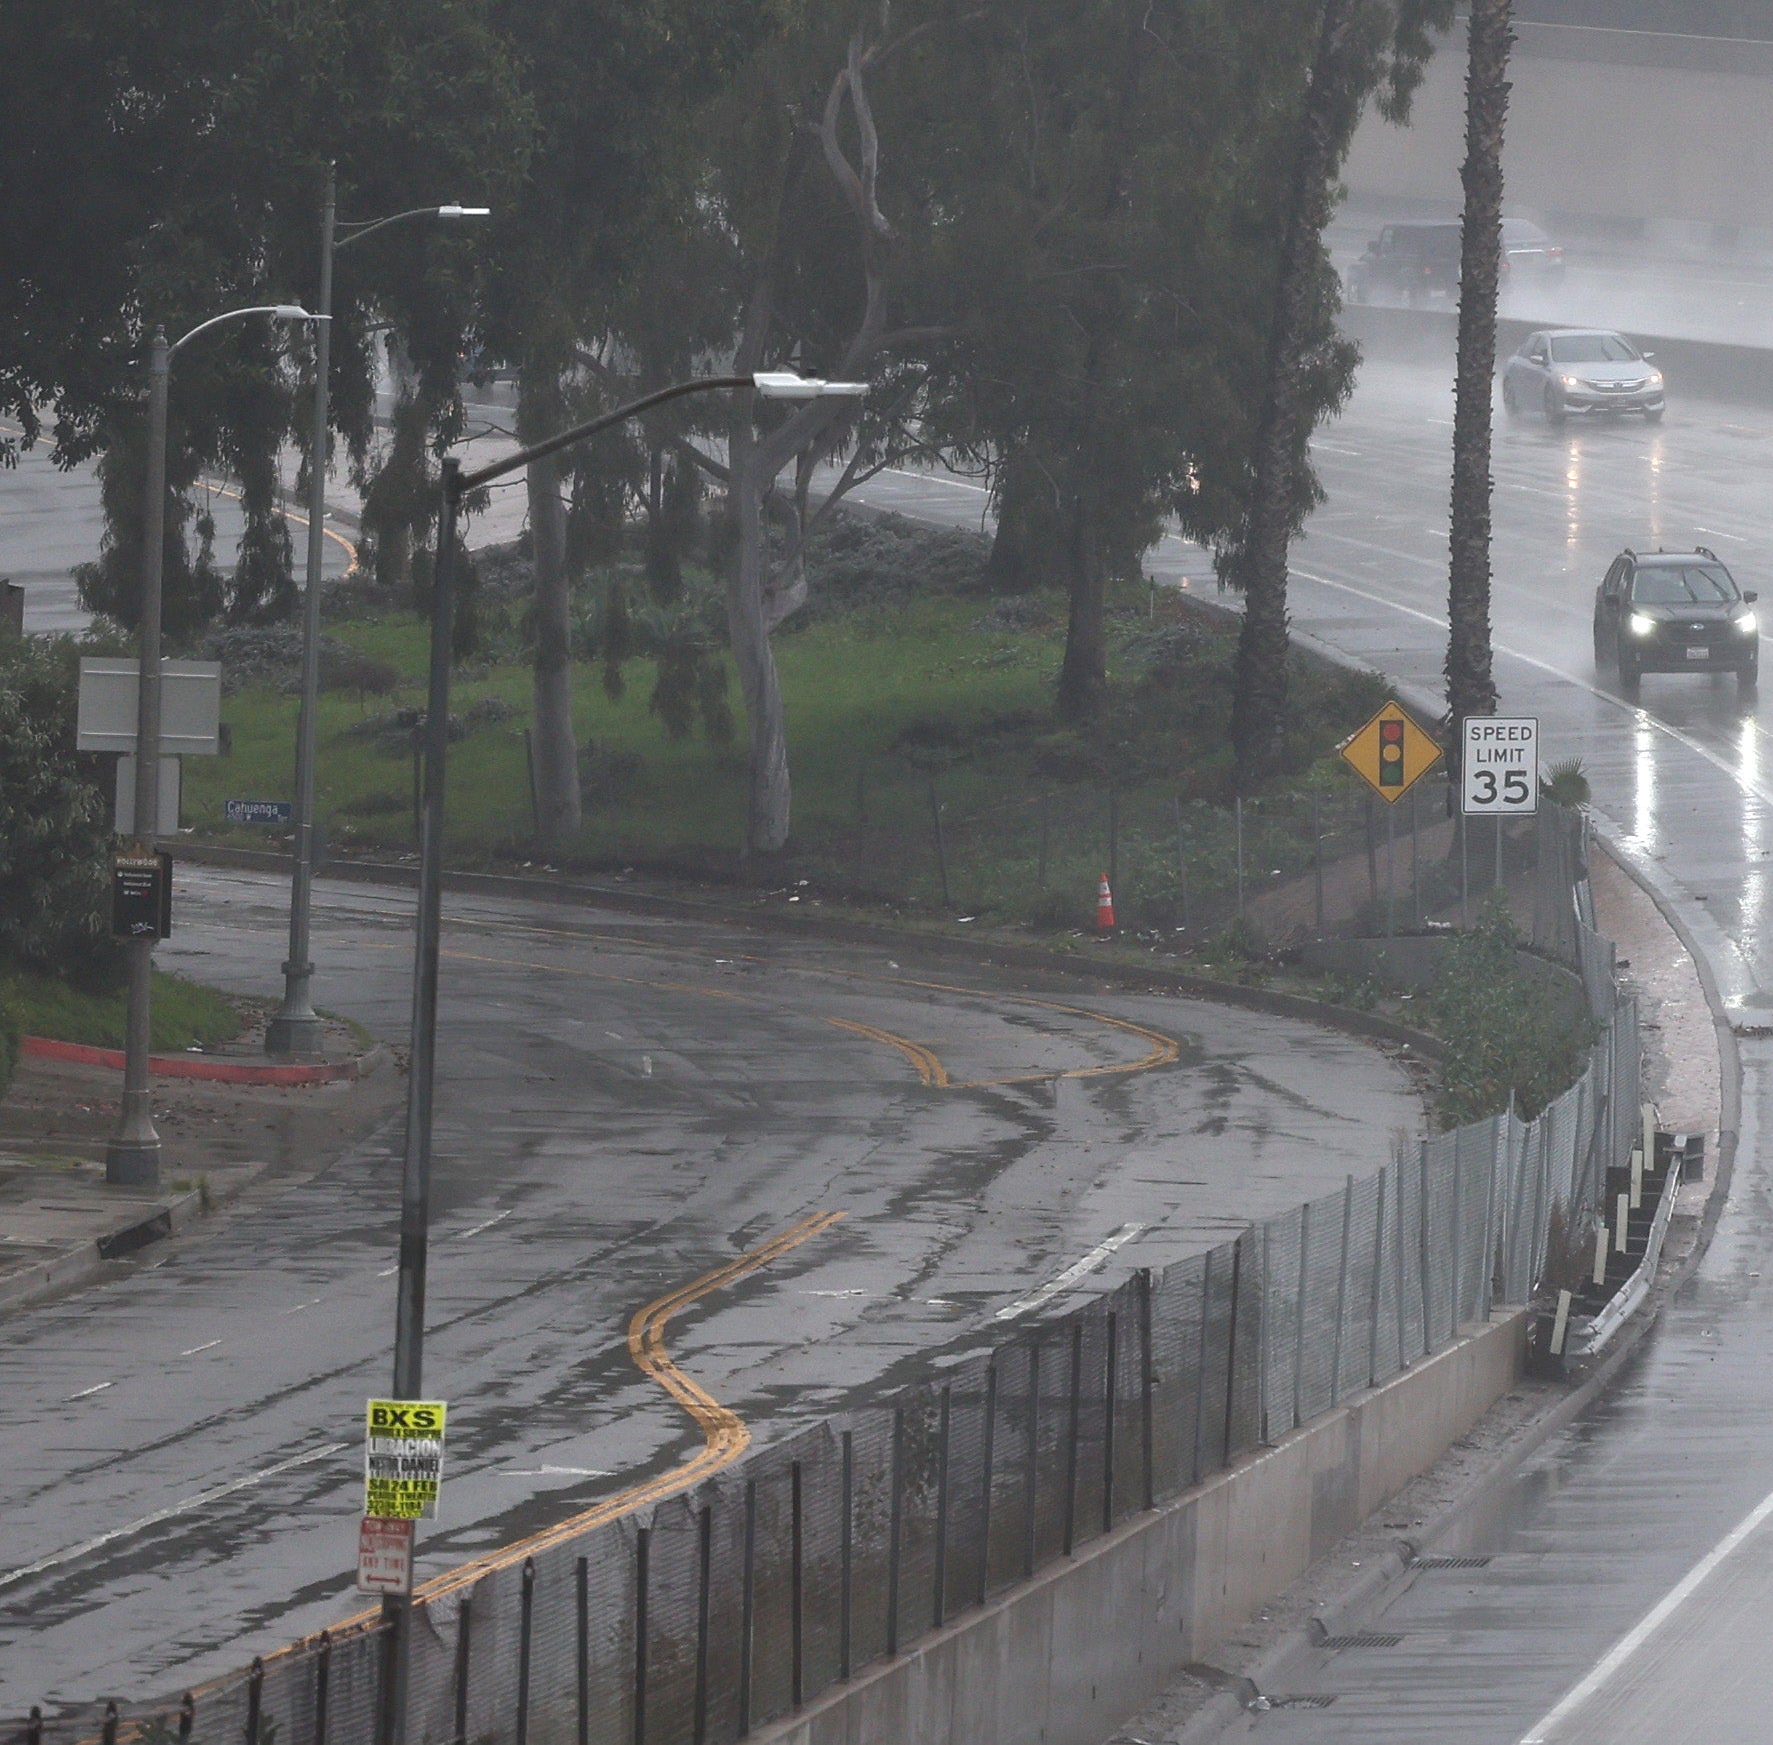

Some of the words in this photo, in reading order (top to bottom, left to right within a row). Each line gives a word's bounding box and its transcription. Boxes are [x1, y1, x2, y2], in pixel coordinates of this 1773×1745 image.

[1471, 726, 1532, 741] SPEED
[1477, 748, 1525, 763] LIMIT
[1471, 770, 1530, 805] 35
[227, 801, 279, 818] Cahuenga
[372, 1407, 437, 1428] BXS
[383, 1557, 405, 1572] TIME
